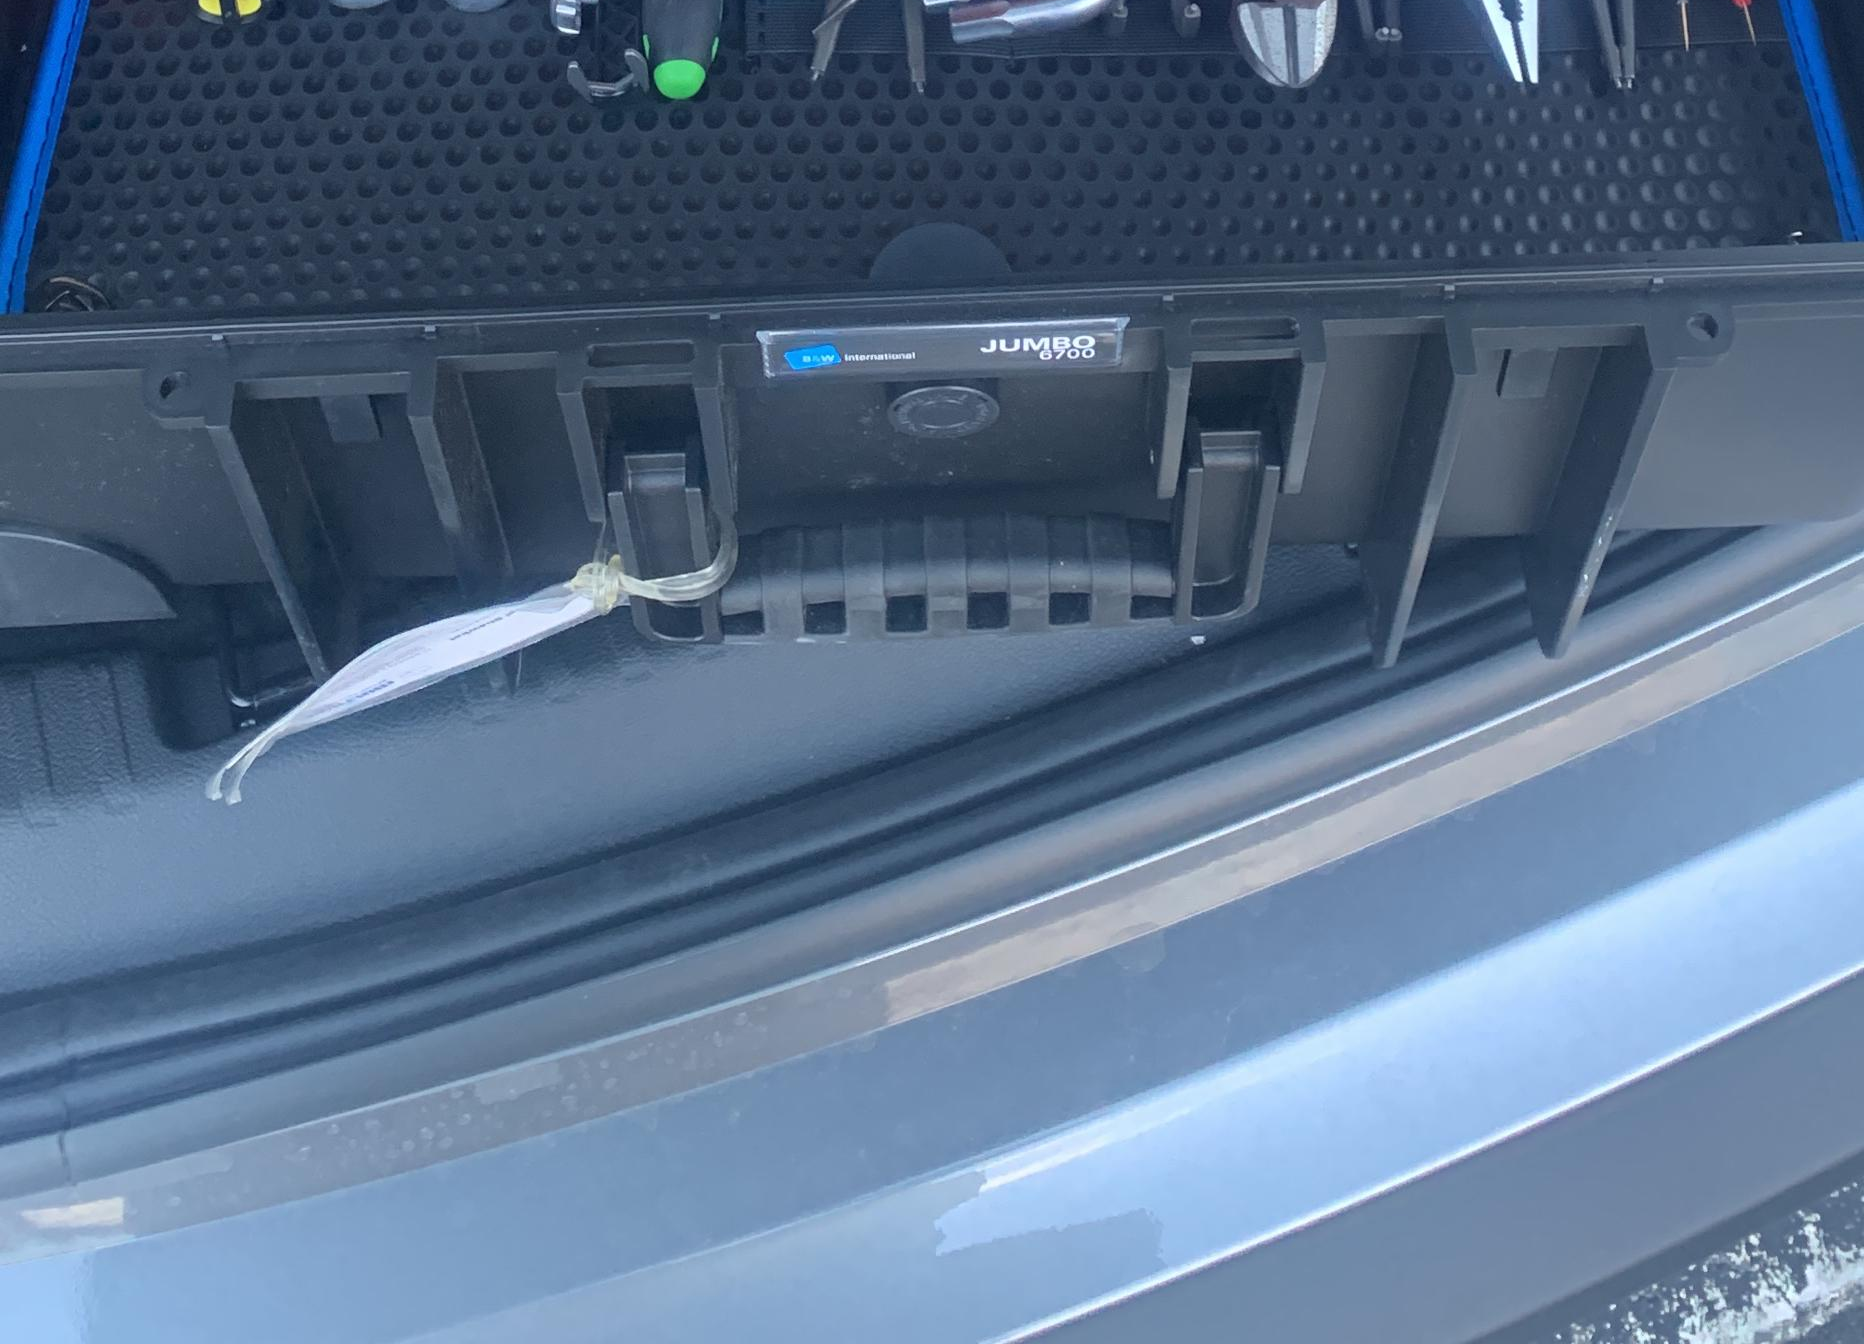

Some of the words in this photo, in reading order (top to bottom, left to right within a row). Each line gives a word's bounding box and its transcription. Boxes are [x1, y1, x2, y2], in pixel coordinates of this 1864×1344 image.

[979, 335, 1097, 353] JUMBO
[844, 351, 917, 362] International
[1038, 347, 1097, 361] 6700
